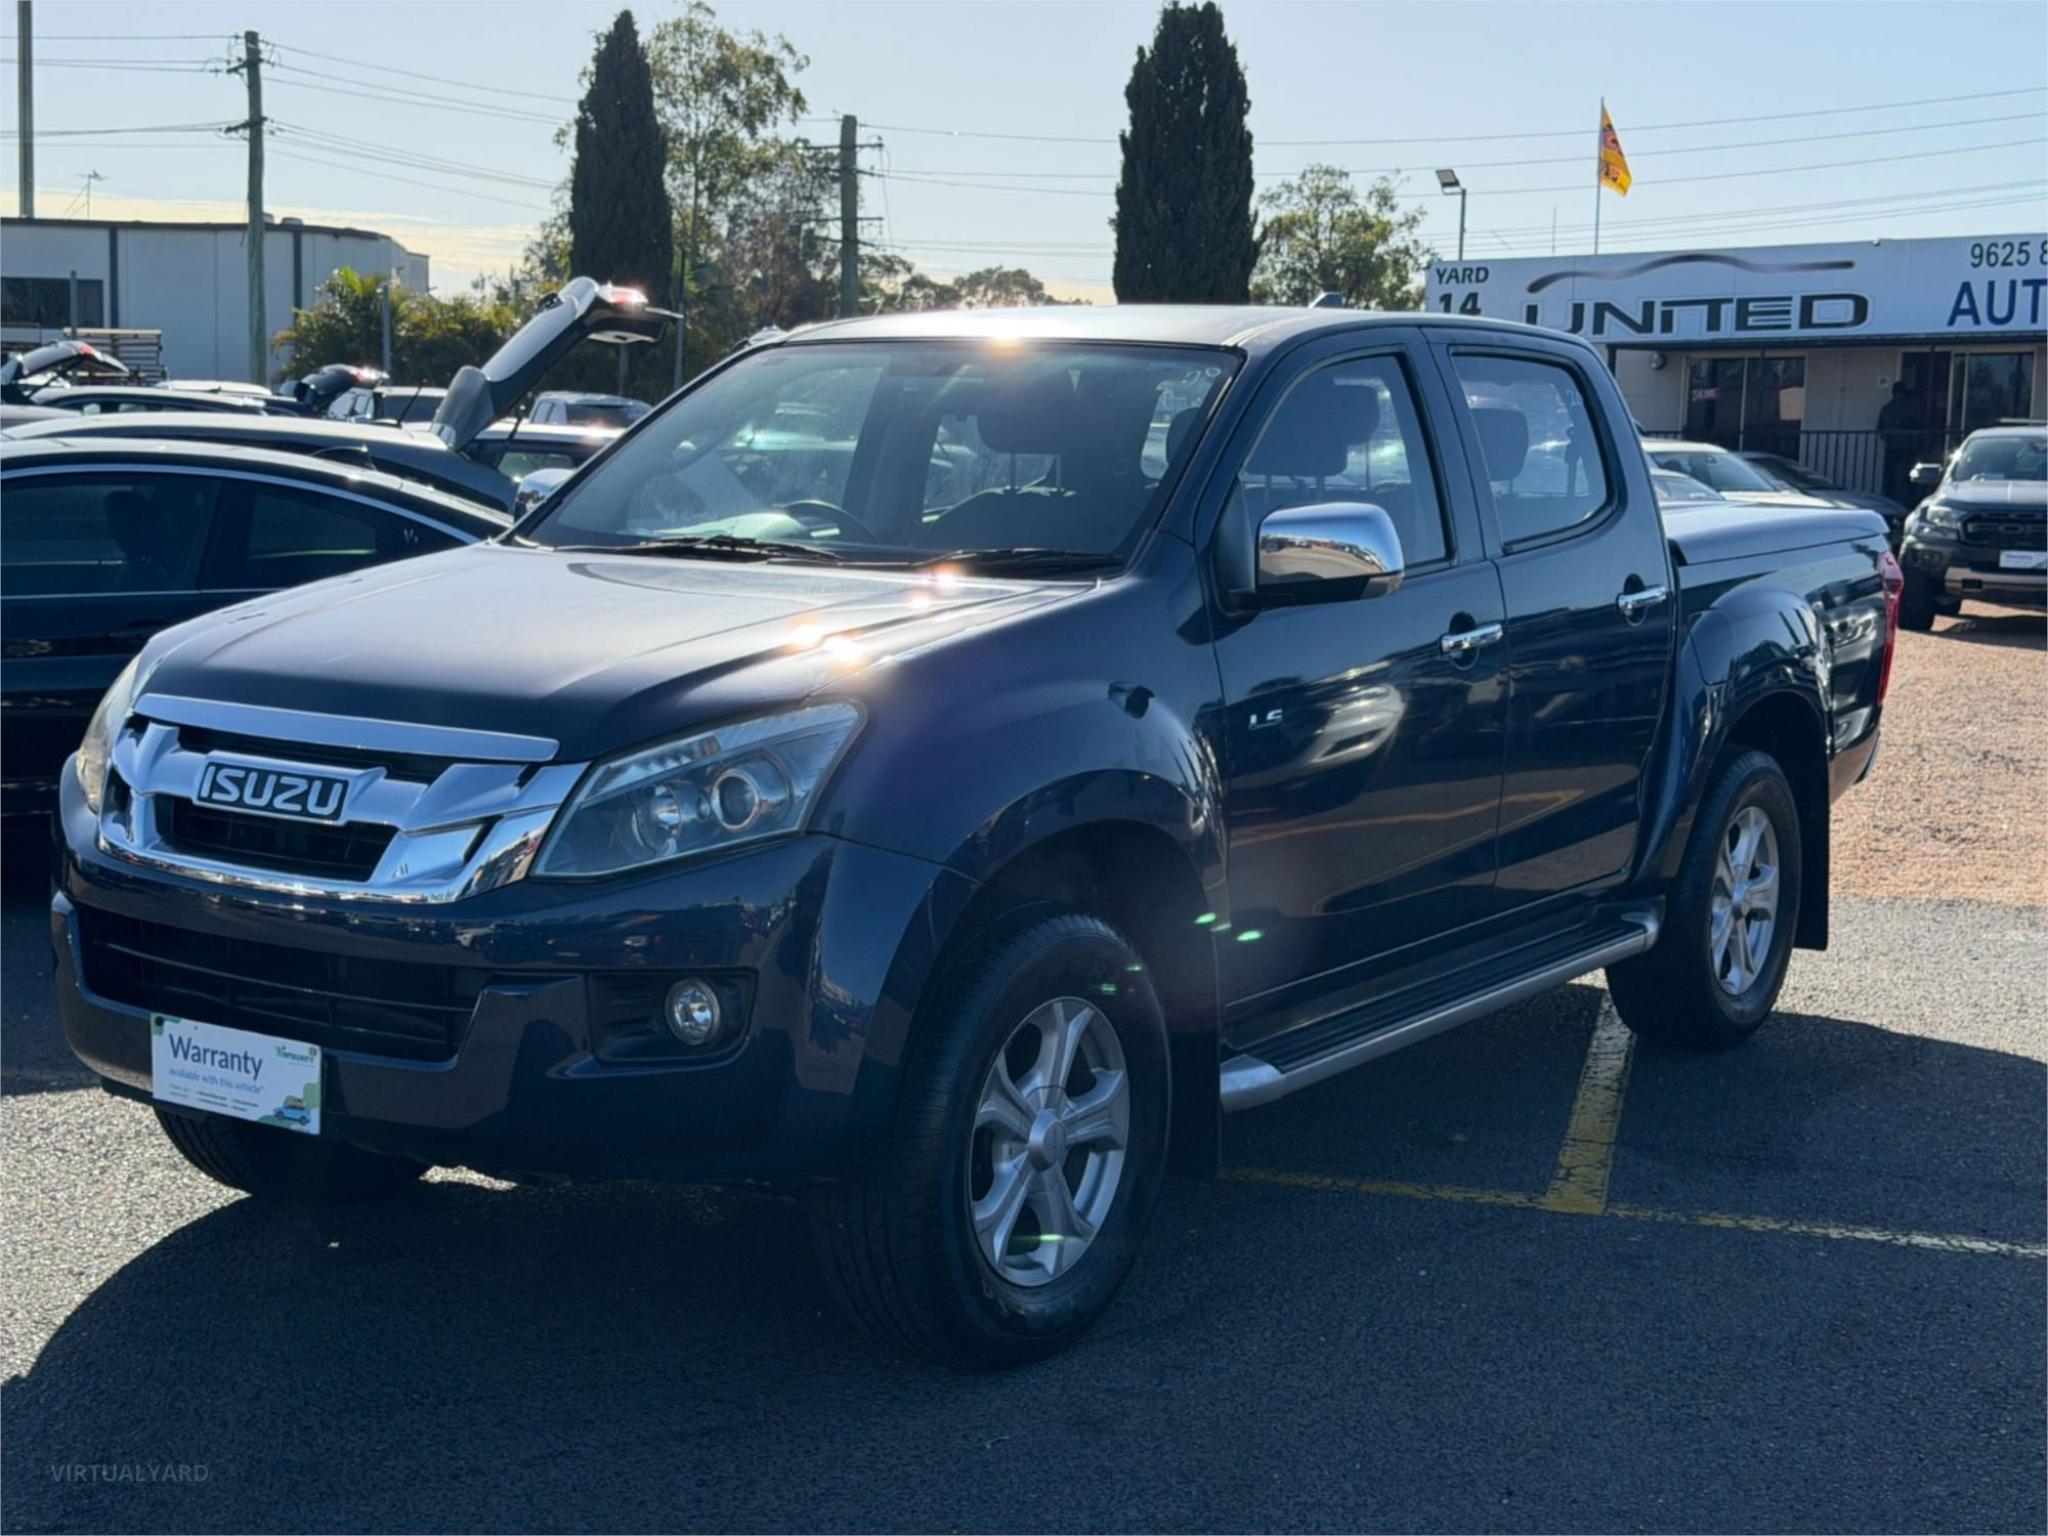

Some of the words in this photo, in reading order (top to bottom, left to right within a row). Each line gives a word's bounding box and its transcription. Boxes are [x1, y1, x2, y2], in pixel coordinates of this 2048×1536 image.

[1435, 266, 1490, 286] YARD
[1970, 241, 2031, 269] 9625
[1439, 292, 1482, 316] 14
[1525, 293, 1869, 336] UNITED
[1946, 278, 2047, 328] AUT
[200, 765, 344, 816] ISUZU
[168, 1032, 264, 1082] Warranty
